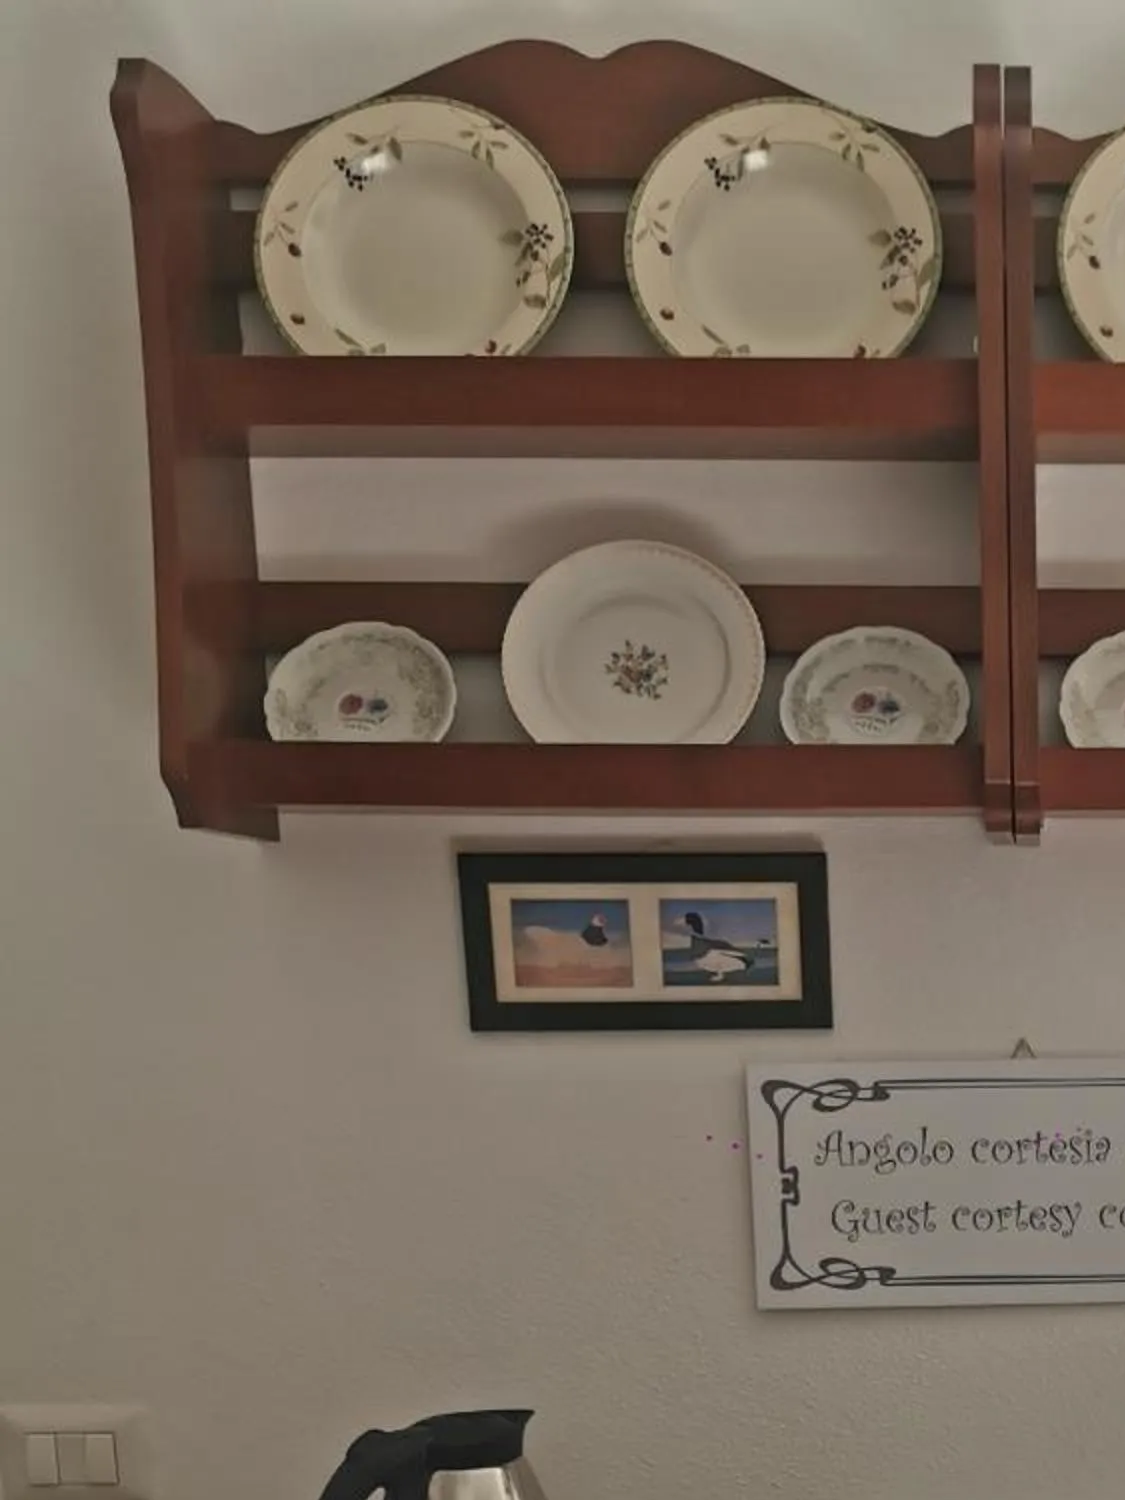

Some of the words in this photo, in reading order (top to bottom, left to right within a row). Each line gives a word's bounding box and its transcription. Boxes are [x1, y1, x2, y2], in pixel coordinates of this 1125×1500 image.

[814, 1126, 954, 1174] Angolo
[971, 1129, 1112, 1165] cortesia
[831, 1200, 937, 1242] Guest
[952, 1200, 1082, 1238] cortesy
